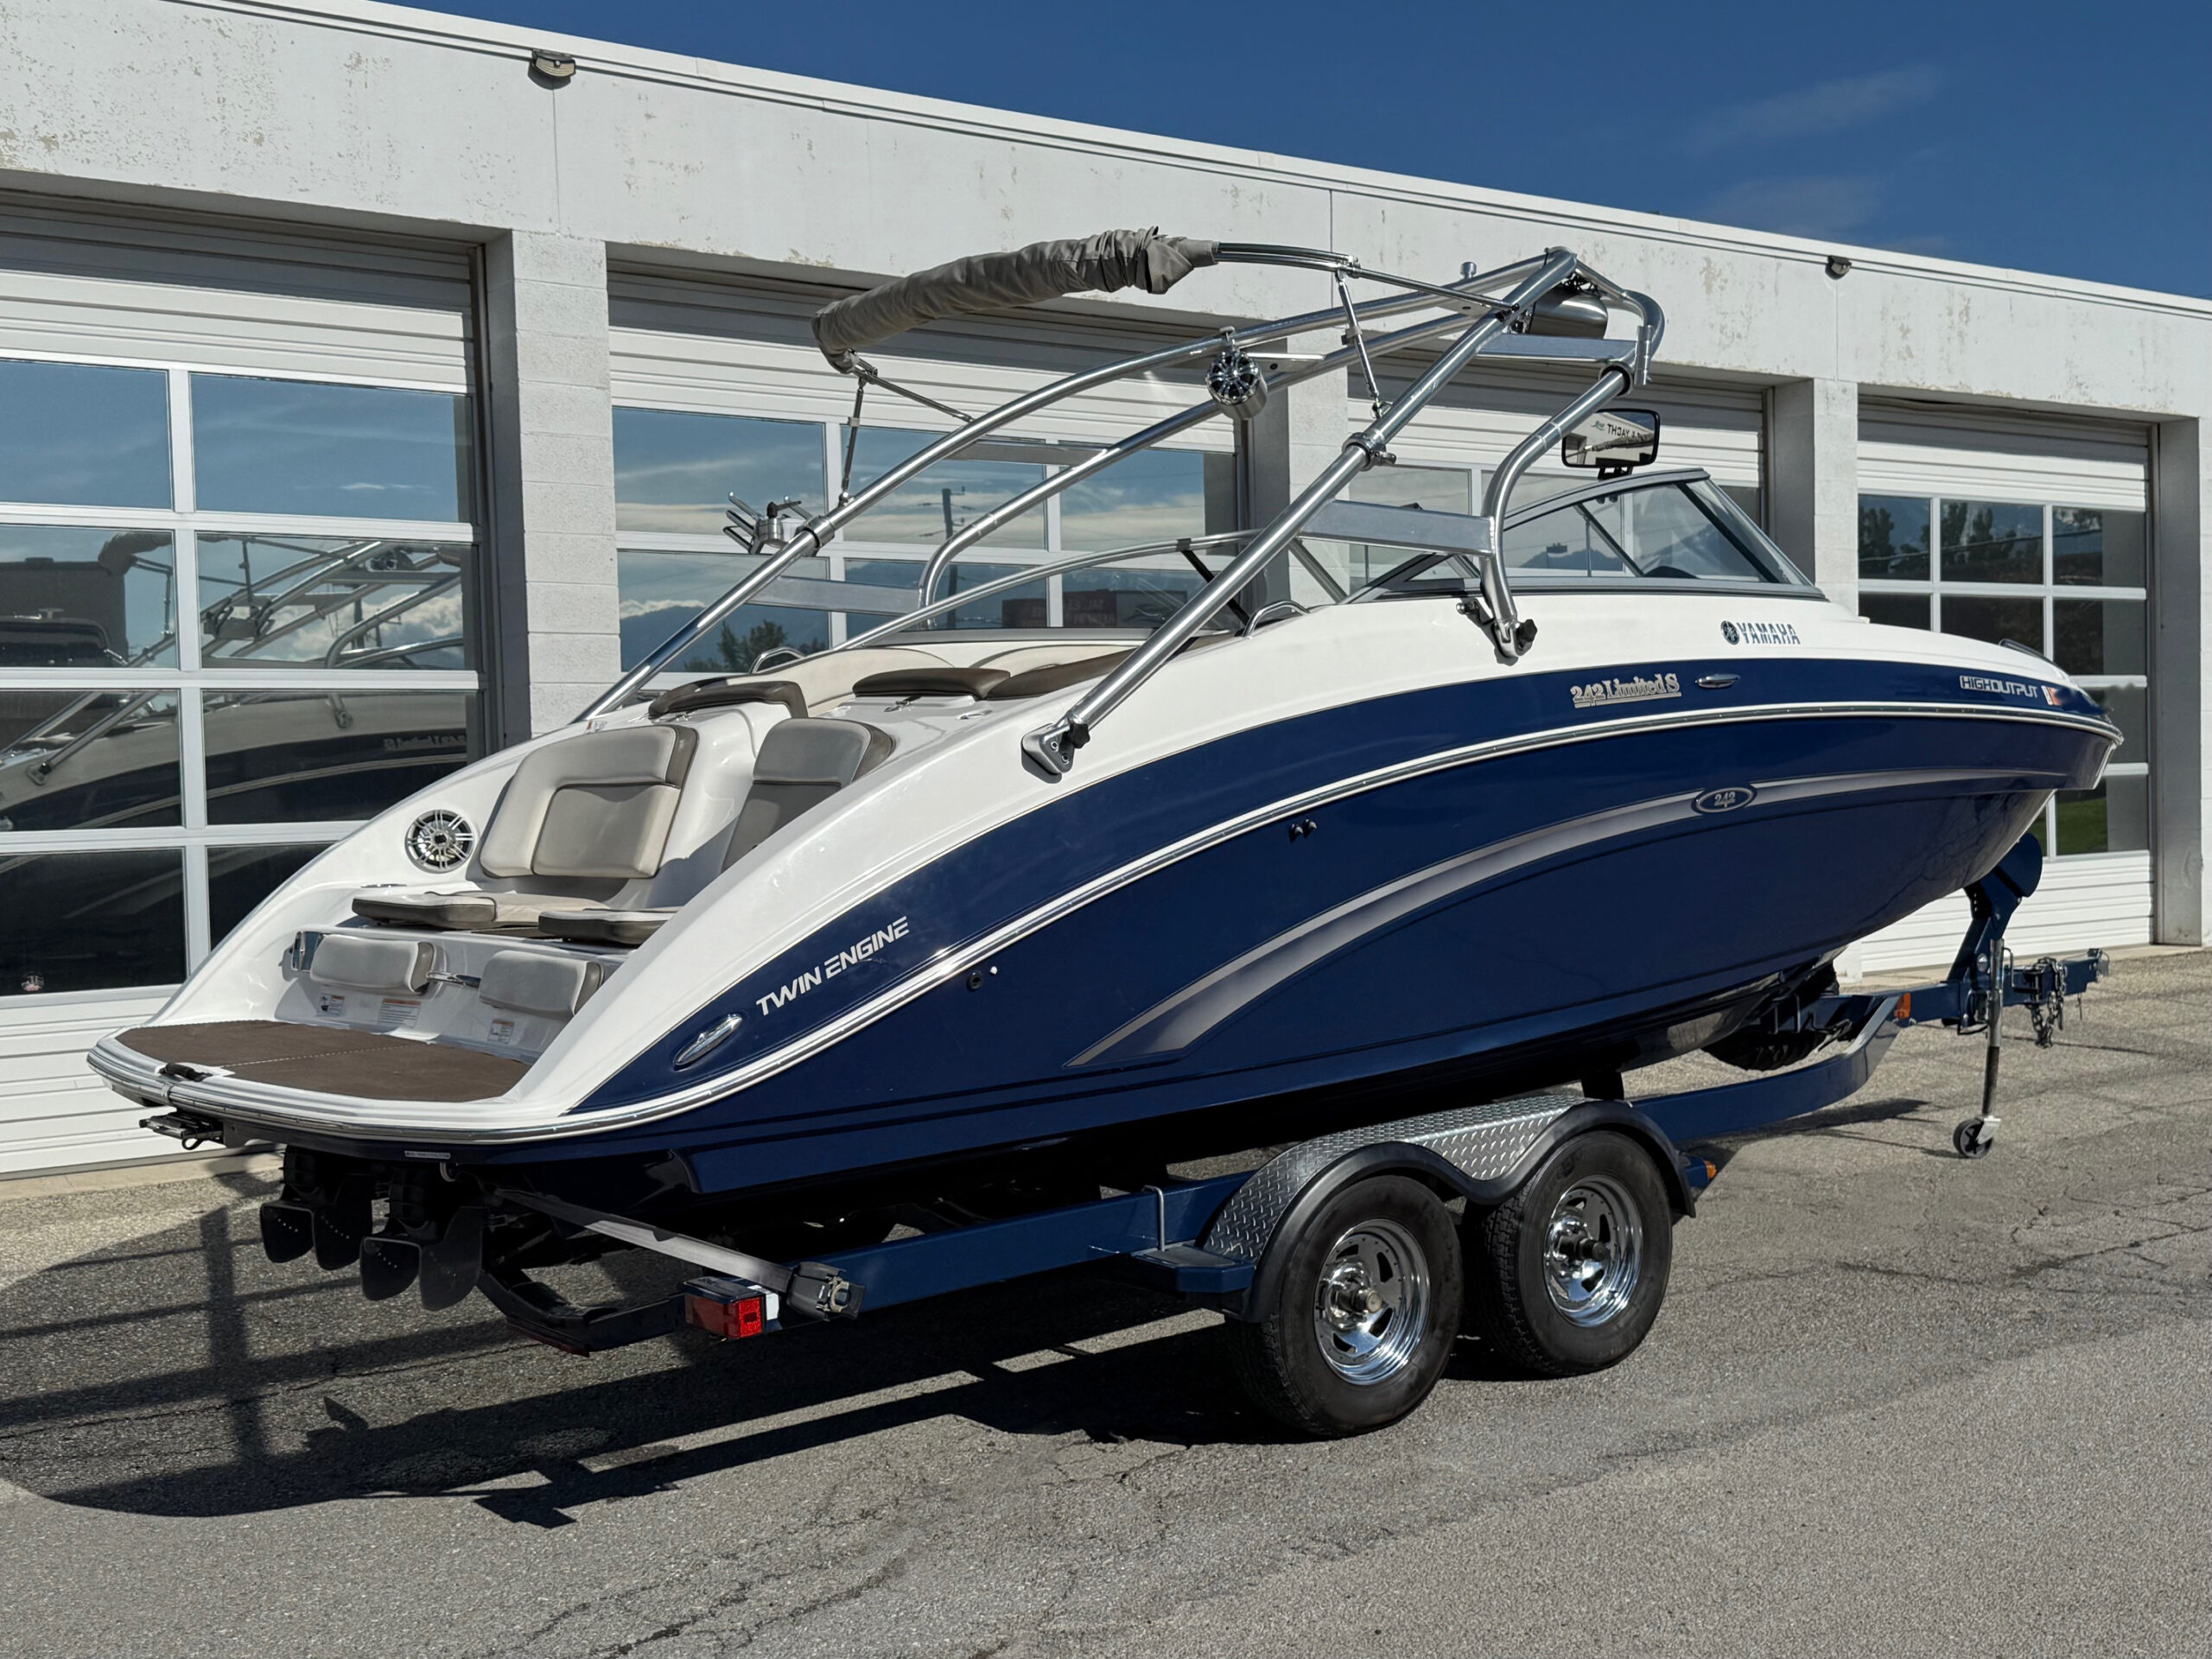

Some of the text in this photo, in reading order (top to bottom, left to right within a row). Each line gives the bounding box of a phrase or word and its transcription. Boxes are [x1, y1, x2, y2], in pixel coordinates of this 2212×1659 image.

[1736, 622, 1801, 645] YAMAHA
[1570, 683, 1606, 706] 242
[1714, 791, 1736, 808] 242
[756, 916, 909, 1016] TWIN ENGINE
